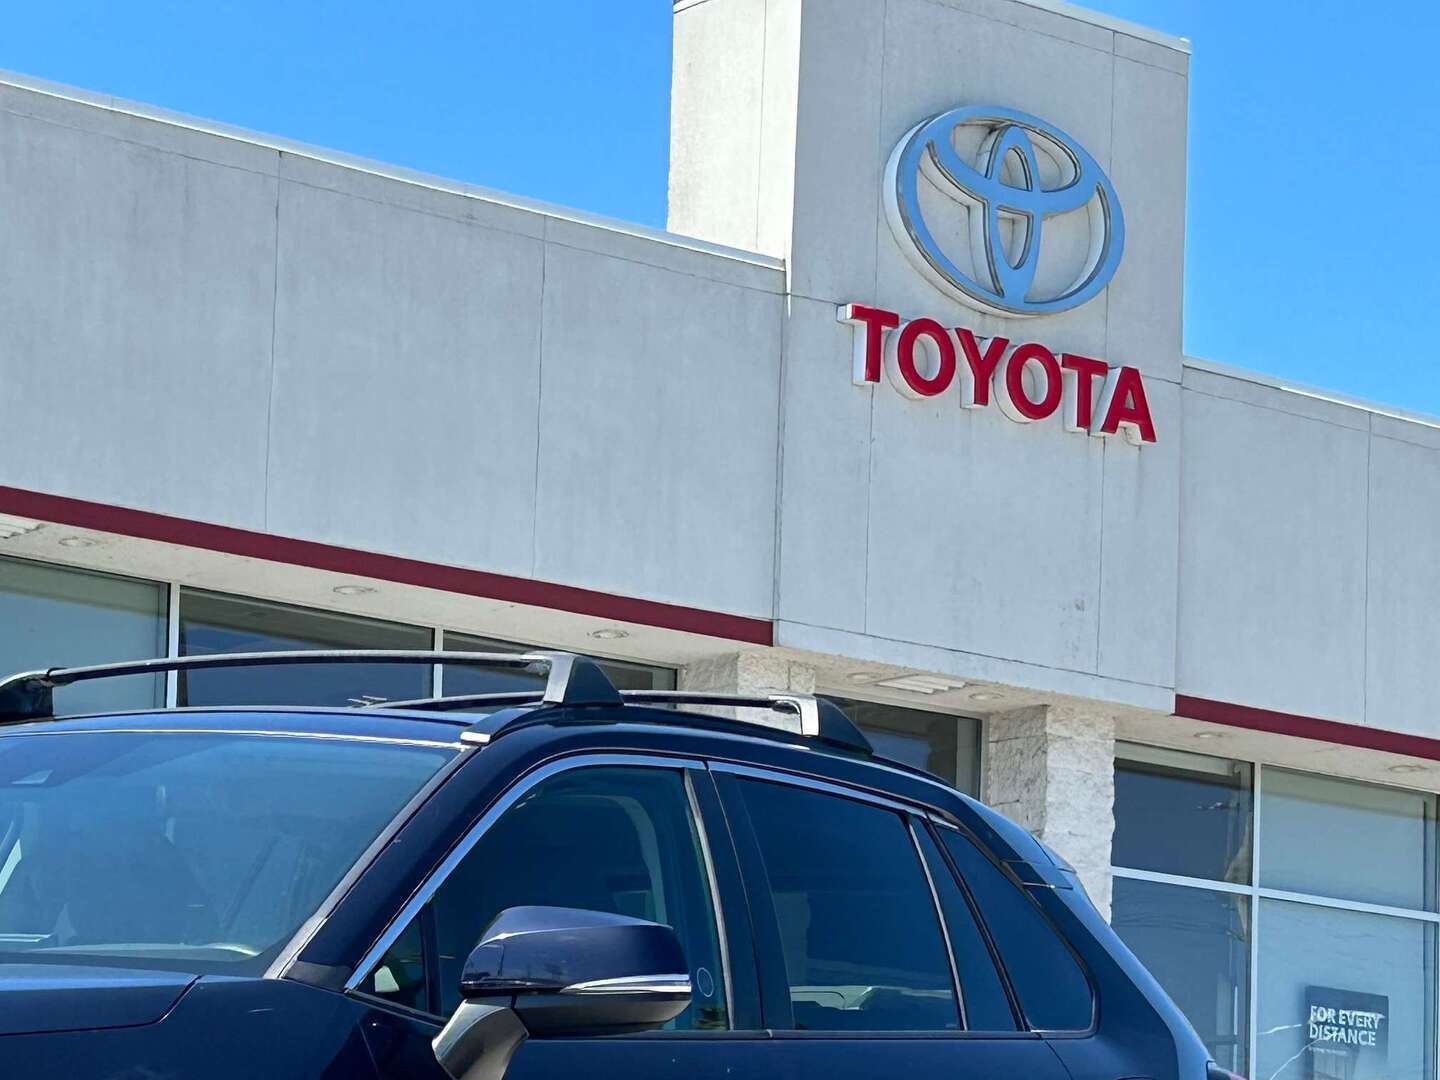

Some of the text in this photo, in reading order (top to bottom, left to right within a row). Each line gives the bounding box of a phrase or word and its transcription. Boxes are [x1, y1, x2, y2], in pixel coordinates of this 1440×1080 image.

[841, 303, 1157, 444] TOYOTA
[1310, 1005, 1381, 1029] FOR EVERY
[1309, 1022, 1376, 1046] DISTANCE
